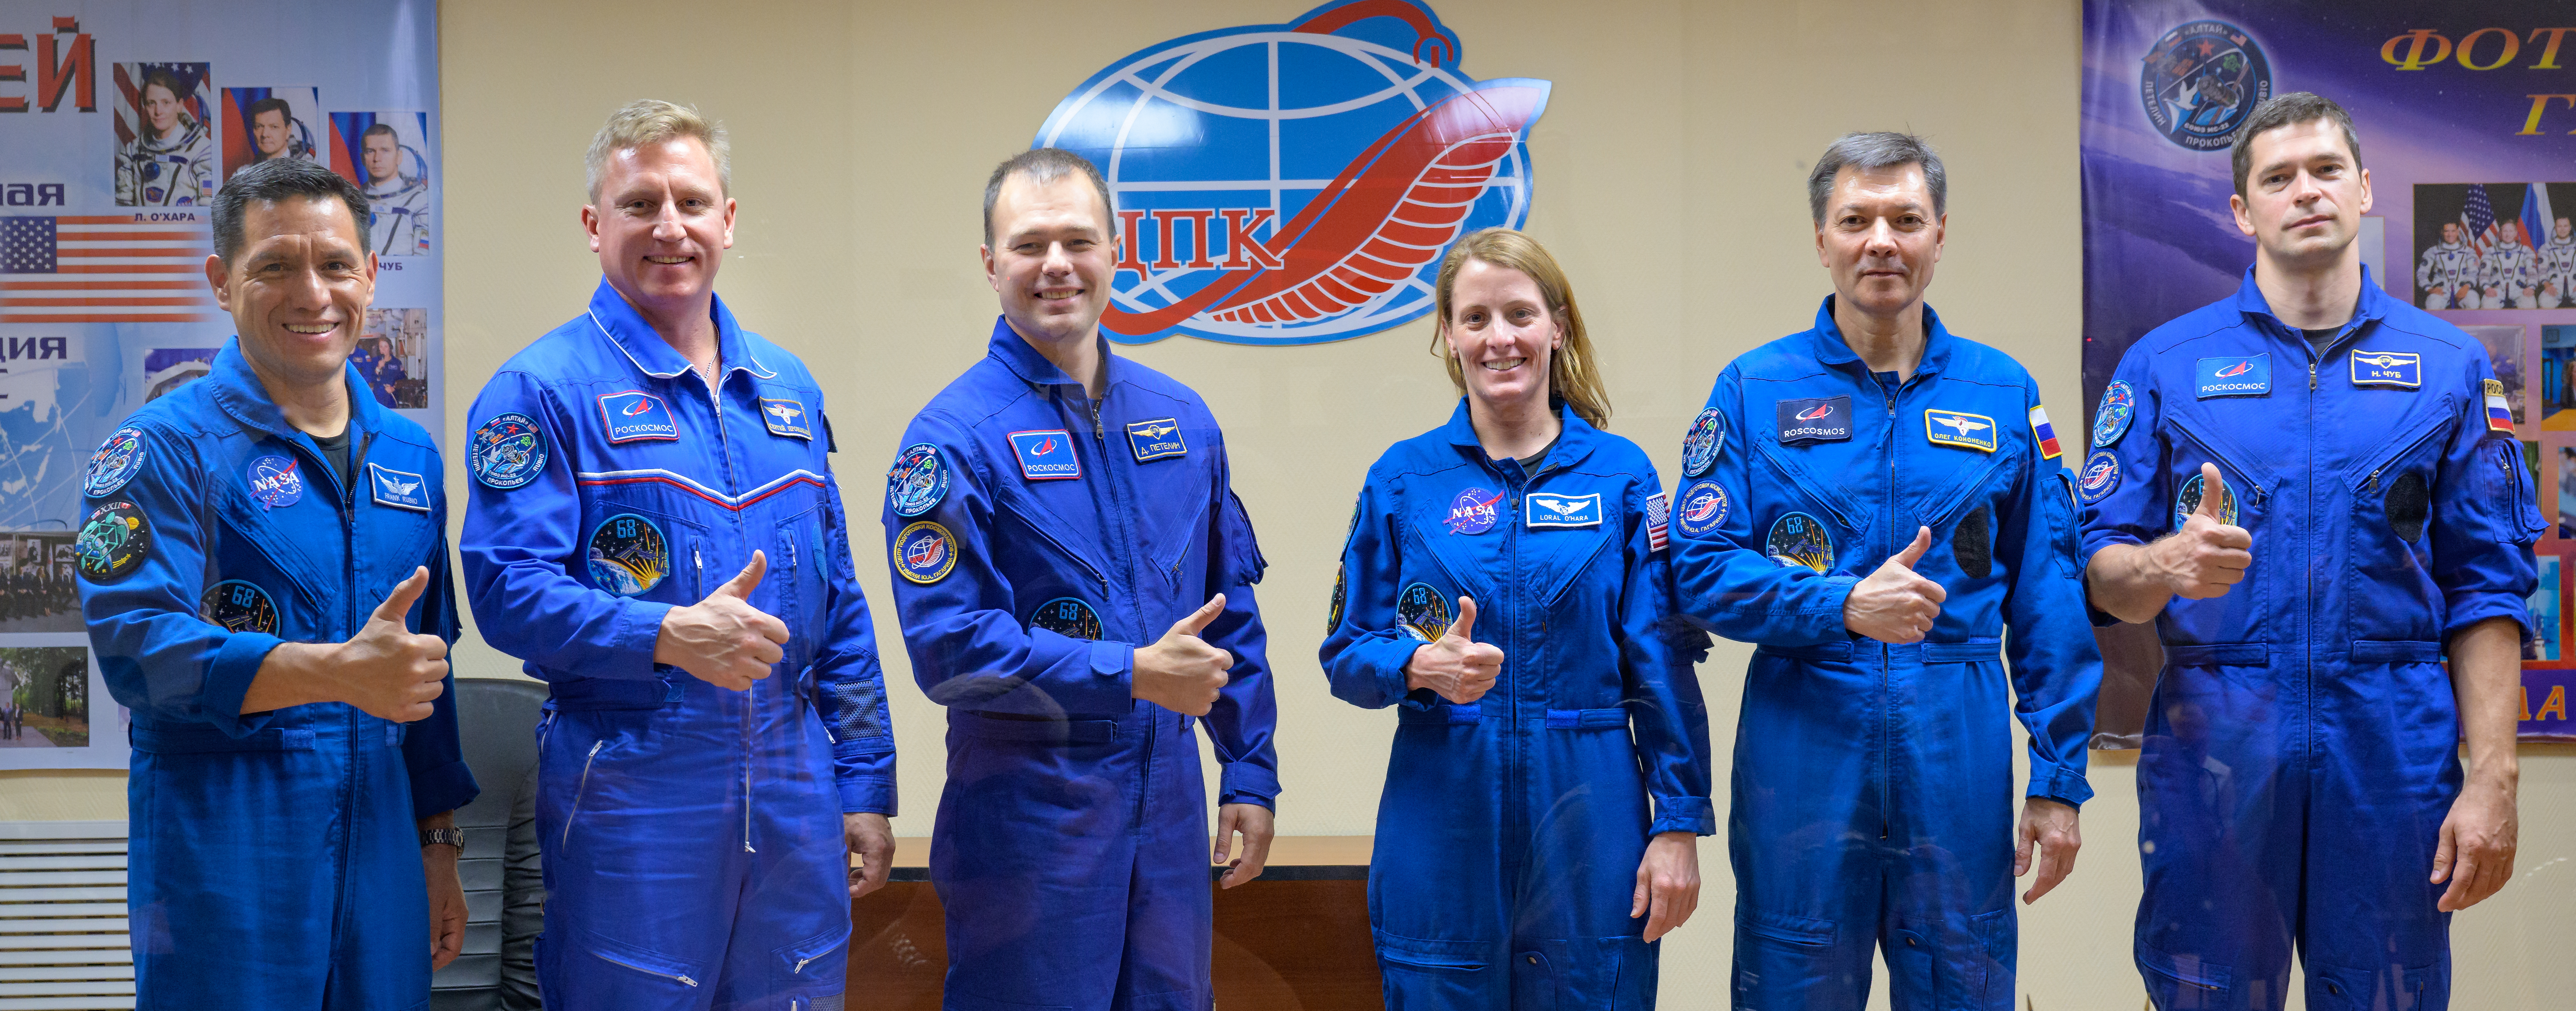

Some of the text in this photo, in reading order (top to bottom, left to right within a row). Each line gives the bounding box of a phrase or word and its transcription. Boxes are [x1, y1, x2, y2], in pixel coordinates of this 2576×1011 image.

[2145, 81, 2166, 126] ПЕТЕЛИН
[2185, 132, 2236, 147] ПРОКОПЬЕ
[0, 183, 64, 206] ая
[134, 212, 195, 222] Л. О'ХАРА
[379, 262, 403, 271] ЧУБ
[0, 337, 67, 363] ИЯ
[2202, 383, 2265, 393] РОСКОСМОС
[502, 415, 528, 425] «АЛТАЙ»
[615, 424, 673, 435] РОСКОСМОС
[1784, 427, 1845, 438] ROSCOSMOS
[1141, 442, 1181, 456] Д. ПЕТЕЛИН
[1954, 435, 1991, 447] КОНОНЕНКО
[133, 452, 144, 470] RUBIO
[472, 444, 481, 472] ПЕТЕЛИН
[532, 453, 545, 472] RUBIO
[253, 471, 300, 492] NASA
[487, 477, 524, 486] ПРОКОПЬЕВ
[2093, 481, 2114, 499] ГАГАРИНА
[384, 492, 418, 504] FRANK RUBIO
[905, 497, 936, 514] ПРОКОПЬЕВ
[1452, 504, 1496, 519] NASA
[616, 519, 636, 538] 68
[1680, 517, 1689, 531] ИМЕНИ
[1700, 513, 1725, 532] ГАГАРИНА
[1786, 517, 1803, 535] 68
[898, 524, 925, 548] ПОДГОТОВКИ
[926, 524, 954, 552] КОСМОНАВТОВ
[903, 567, 920, 579] ИМЕНИ
[933, 558, 953, 578] ГАГАРИНА
[232, 585, 255, 608] 68
[1413, 588, 1427, 605] 68
[1059, 602, 1078, 621] 68
